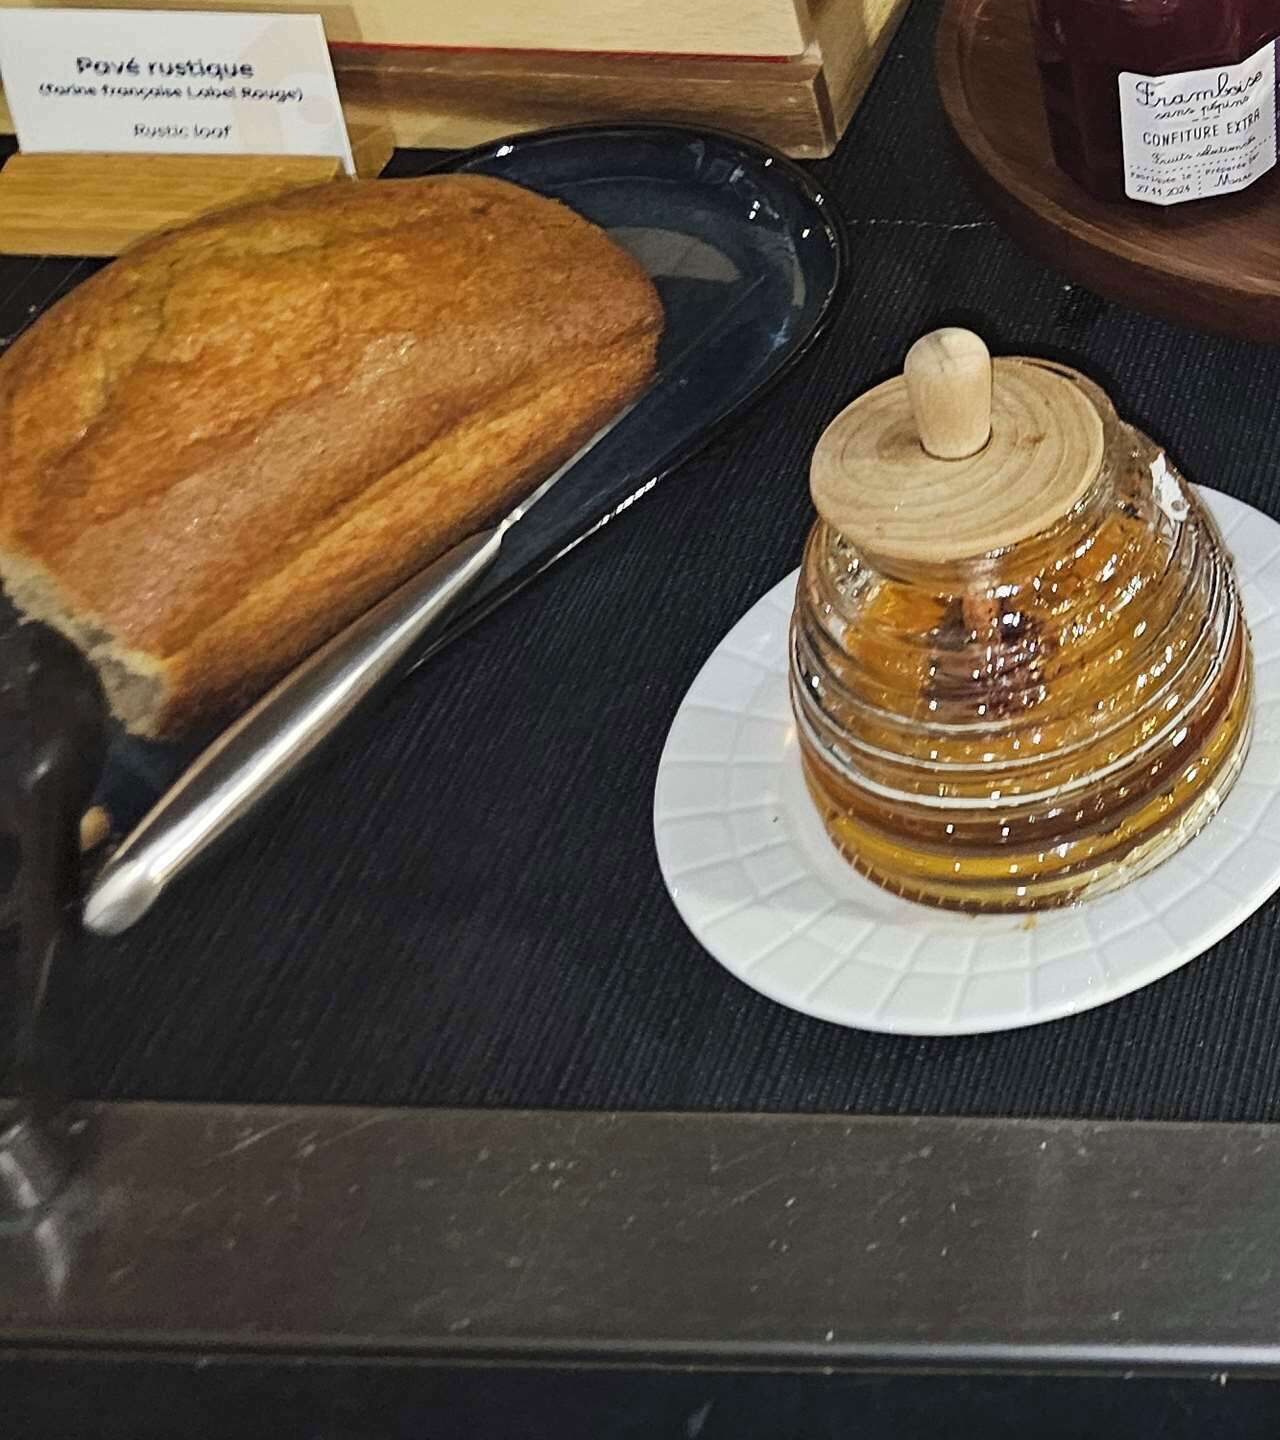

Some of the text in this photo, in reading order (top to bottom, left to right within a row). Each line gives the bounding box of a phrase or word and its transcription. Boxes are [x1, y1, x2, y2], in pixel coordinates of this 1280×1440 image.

[76, 56, 255, 81] Pavé rustique
[1135, 71, 1264, 109] Framboise
[133, 122, 232, 139] Rustic loaf
[1142, 108, 1262, 148] CONFITURE EXTRA
